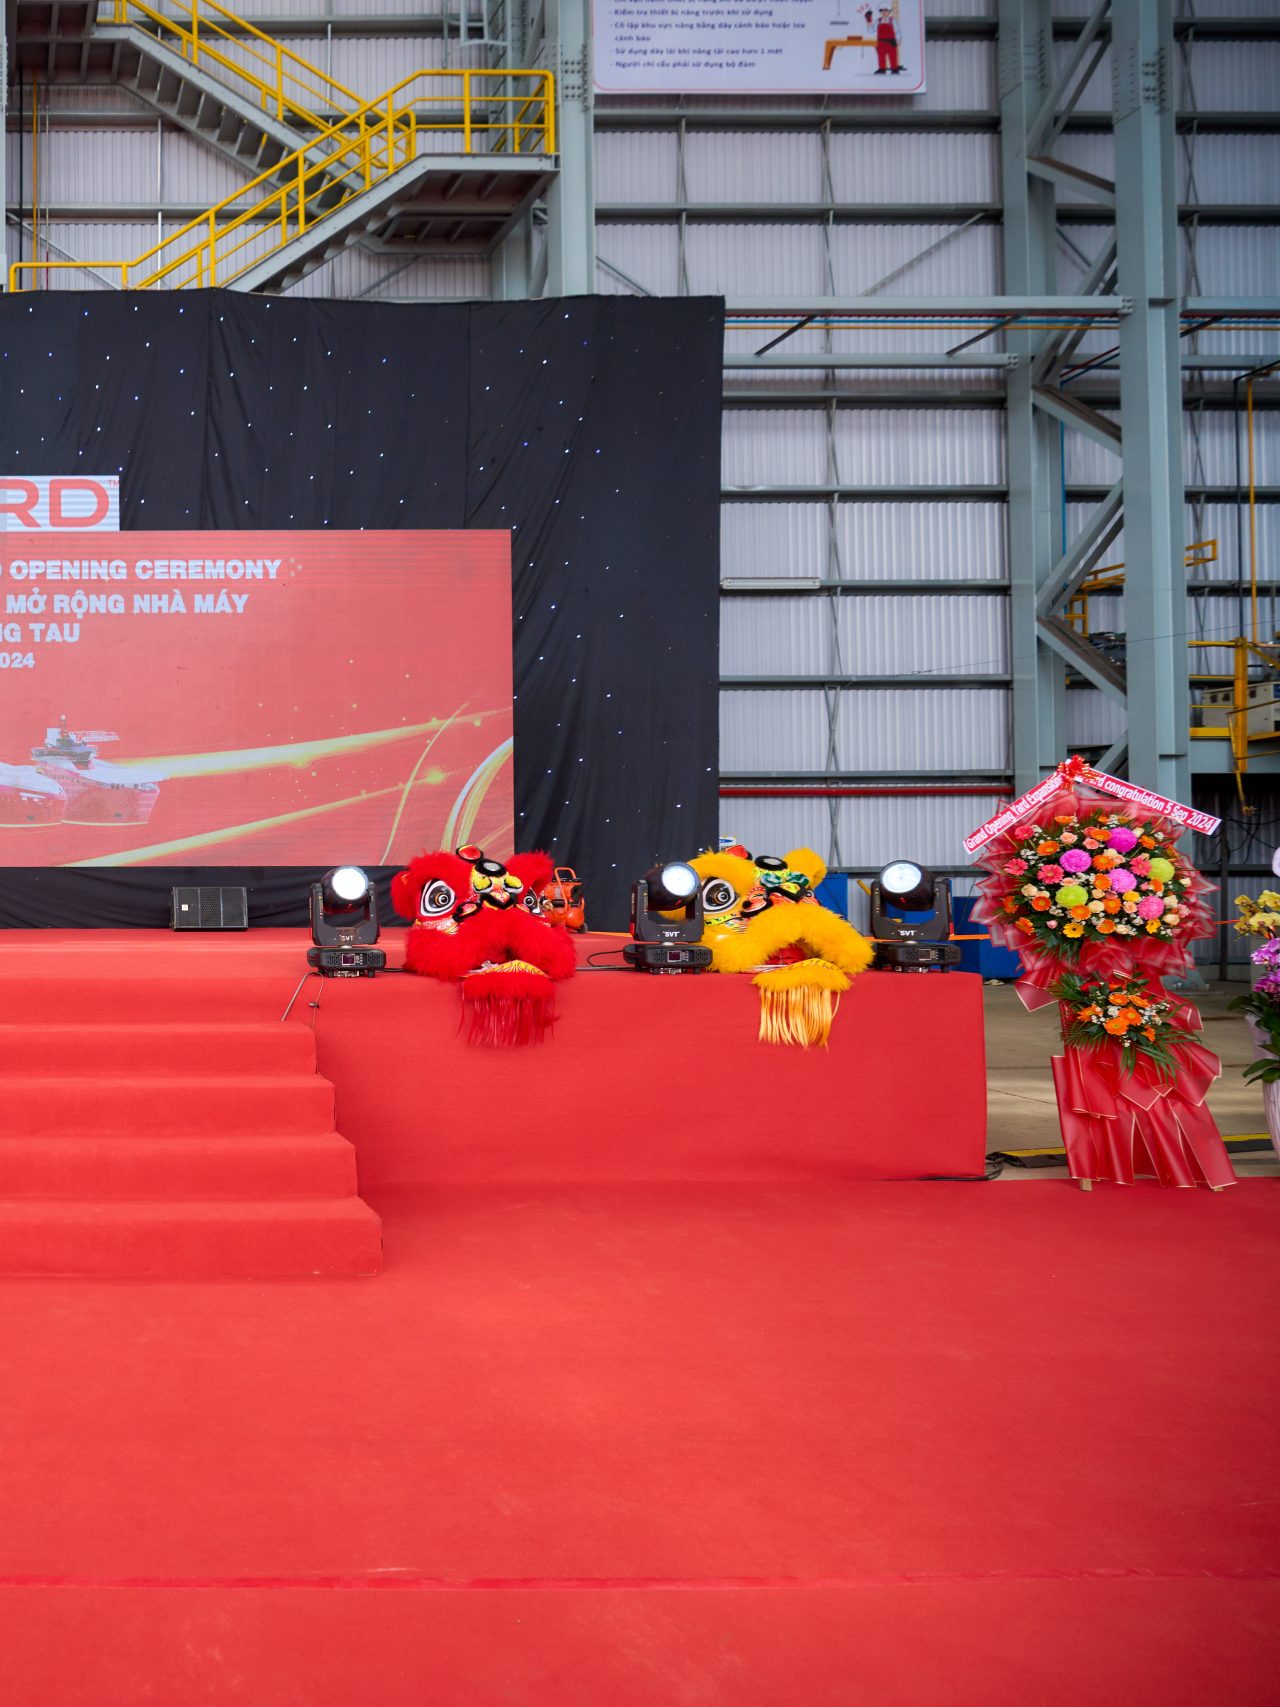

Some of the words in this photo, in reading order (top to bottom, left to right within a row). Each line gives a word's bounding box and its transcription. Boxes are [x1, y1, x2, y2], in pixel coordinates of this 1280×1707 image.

[9, 559, 127, 580] OPENING
[135, 559, 282, 580] CEREMONY
[5, 587, 47, 614] MỞ
[53, 590, 125, 619] RỘNG
[133, 589, 187, 614] NHÀ
[194, 588, 249, 614] MÁY
[29, 623, 80, 642] TAU
[1104, 780, 1165, 812] congratulation
[1163, 802, 1174, 814] 5
[1170, 805, 1188, 821] Sep
[1186, 812, 1214, 831] 2024
[966, 828, 988, 849] Grand
[984, 811, 1015, 835] Opening
[1010, 801, 1030, 816] Yard
